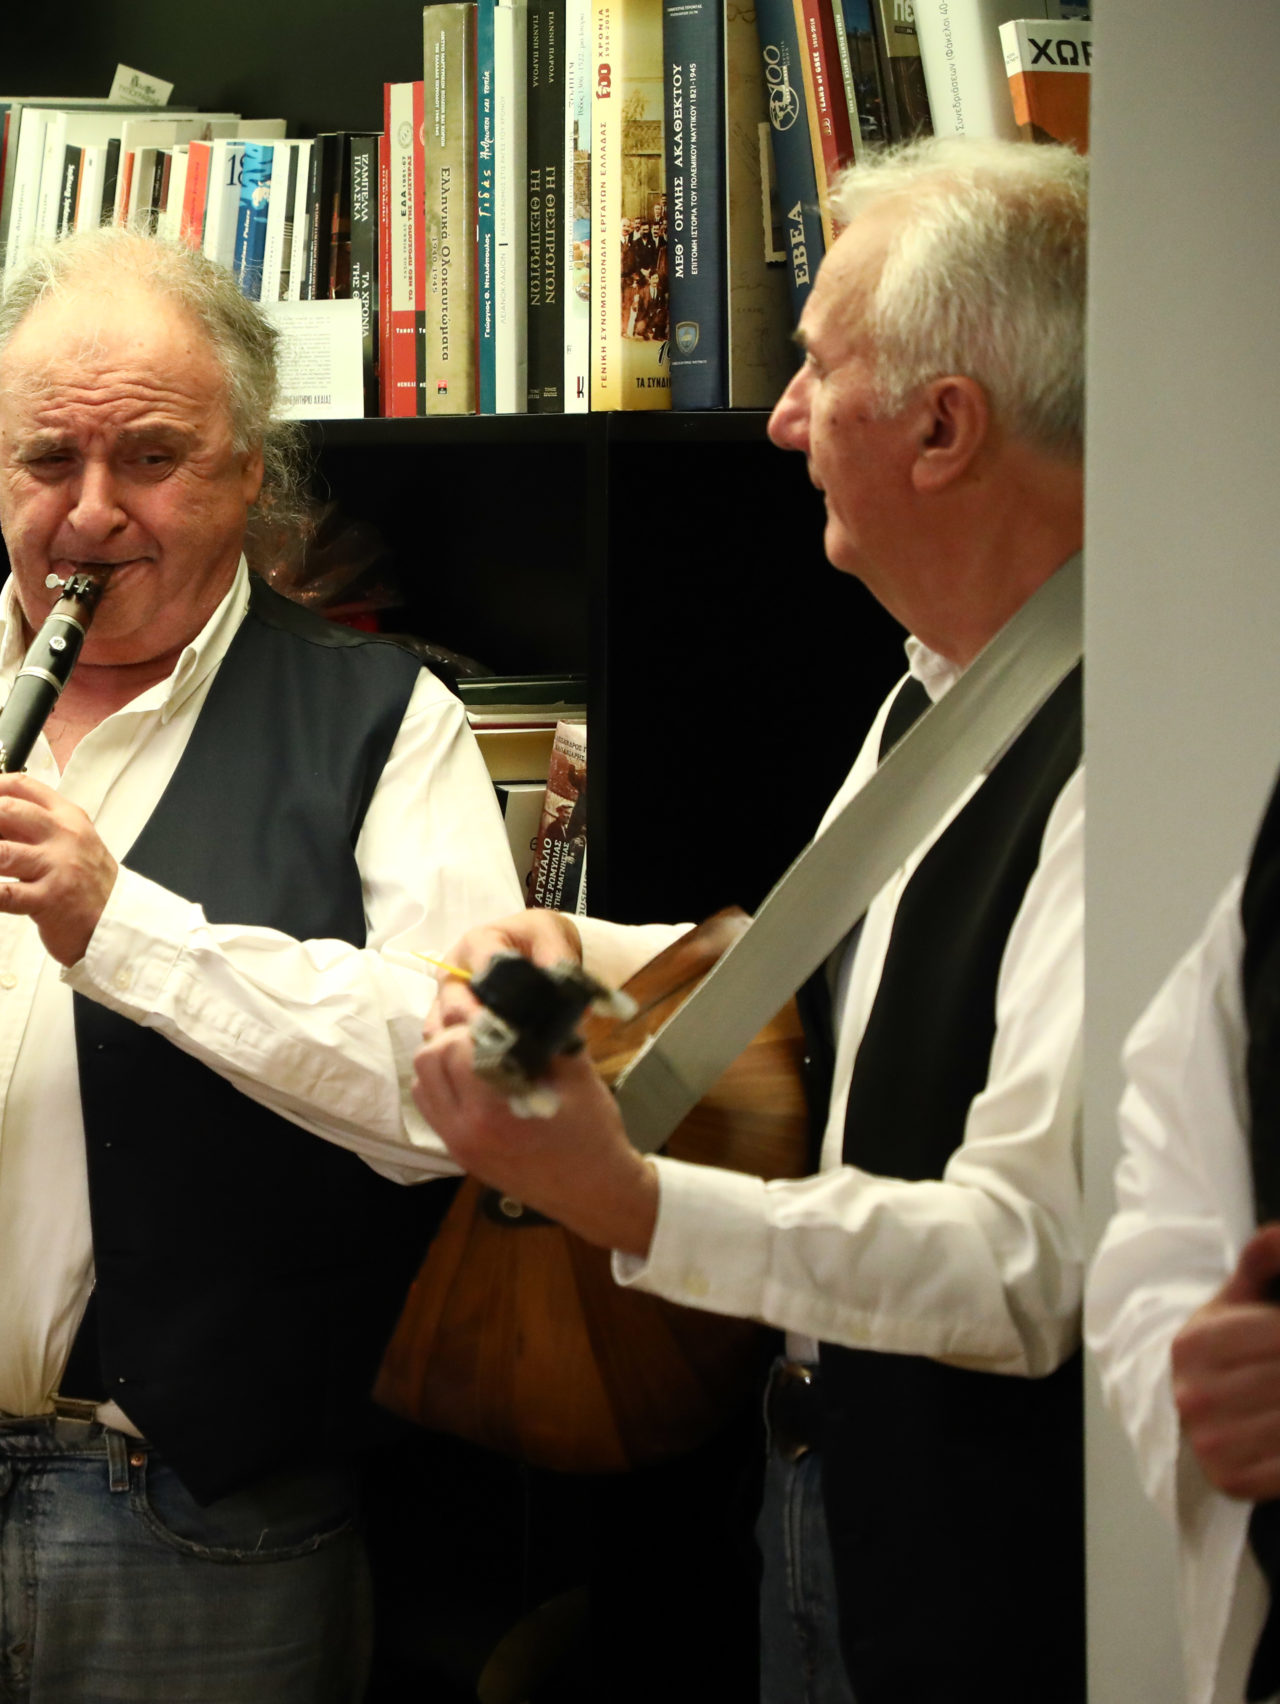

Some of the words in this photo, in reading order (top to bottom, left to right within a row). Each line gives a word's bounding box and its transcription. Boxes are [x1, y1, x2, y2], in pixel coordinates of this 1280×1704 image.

[943, 17, 957, 61] (Φάκελοι
[689, 63, 698, 103] 1821-1945
[812, 51, 822, 73] GSEE
[816, 75, 823, 84] of
[672, 63, 683, 168] ΑΚΑΘΕΚΤΟΥ
[818, 86, 827, 113] YEARS
[950, 63, 966, 131] Συνεδριάσεων
[690, 104, 698, 143] ΝΑΥΤΙΚΟΥ
[600, 122, 608, 176] ΕΛΛΑΔΑΣ
[690, 144, 698, 189] ΠΟΛΕΜΙΚΟΥ
[353, 155, 361, 221] ΠΑΛΑΣΚΑ
[360, 154, 369, 222] ΙΖΑΜΠΕΛΛΑ
[530, 169, 541, 192] ΓΗ
[545, 166, 556, 189] ΓΗ
[690, 190, 698, 206] ΤΟΥ
[440, 167, 451, 240] Ελληνικά
[600, 181, 608, 233] ΕΡΓΑΤΩΝ
[673, 175, 684, 231] ΟΡΜΗΣ
[690, 207, 698, 238] ΙΣΤΟΡΙΑ
[530, 195, 541, 306] ΘΕΣΠΡΩΤΩΝ
[545, 193, 556, 304] ΘΕΣΠΡΩΤΩΝ
[690, 239, 699, 275] ΕΠΙΤΟΜΗ
[786, 201, 810, 288] ΕΒΕΑ
[352, 262, 361, 287] ΤΗΣ
[362, 271, 370, 290] ΤΑ
[600, 239, 608, 341] ΣΥΝΟΜΟΣΠΟΝΔΙΑ
[362, 292, 370, 338] ΧΡΟΝΙΑ
[440, 245, 451, 361] Ολοκαυτώματα
[484, 300, 492, 338] Γεώργιος
[636, 377, 645, 389] ΤΑ
[534, 838, 553, 904] ΑΓΧΙΑΛΟ
[547, 839, 562, 891] ΡΩΜΥΛΙΑΣ
[554, 890, 562, 906] ΤΗΣ
